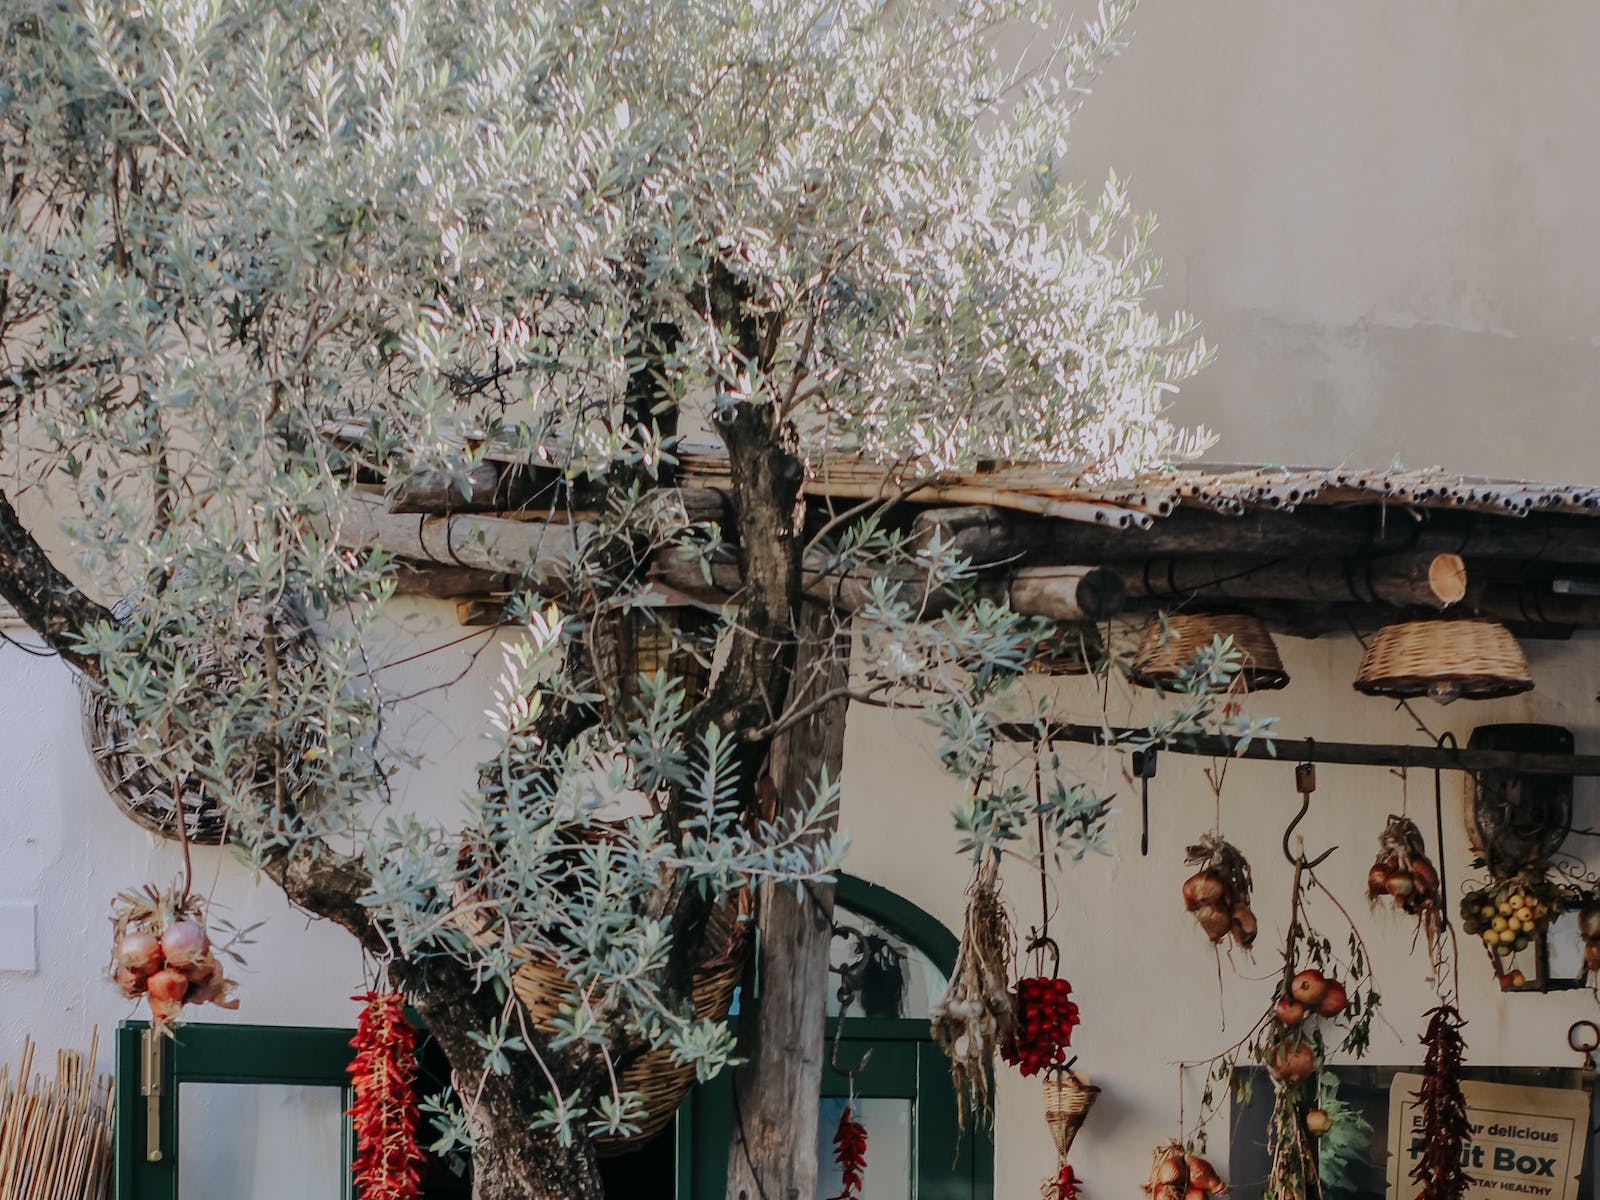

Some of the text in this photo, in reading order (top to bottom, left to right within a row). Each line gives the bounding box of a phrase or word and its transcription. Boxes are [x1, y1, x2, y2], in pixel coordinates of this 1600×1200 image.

[1488, 1124, 1559, 1143] delicious
[1410, 1137, 1557, 1177] Fit Box
[1500, 1182, 1552, 1196] HEALTHY
